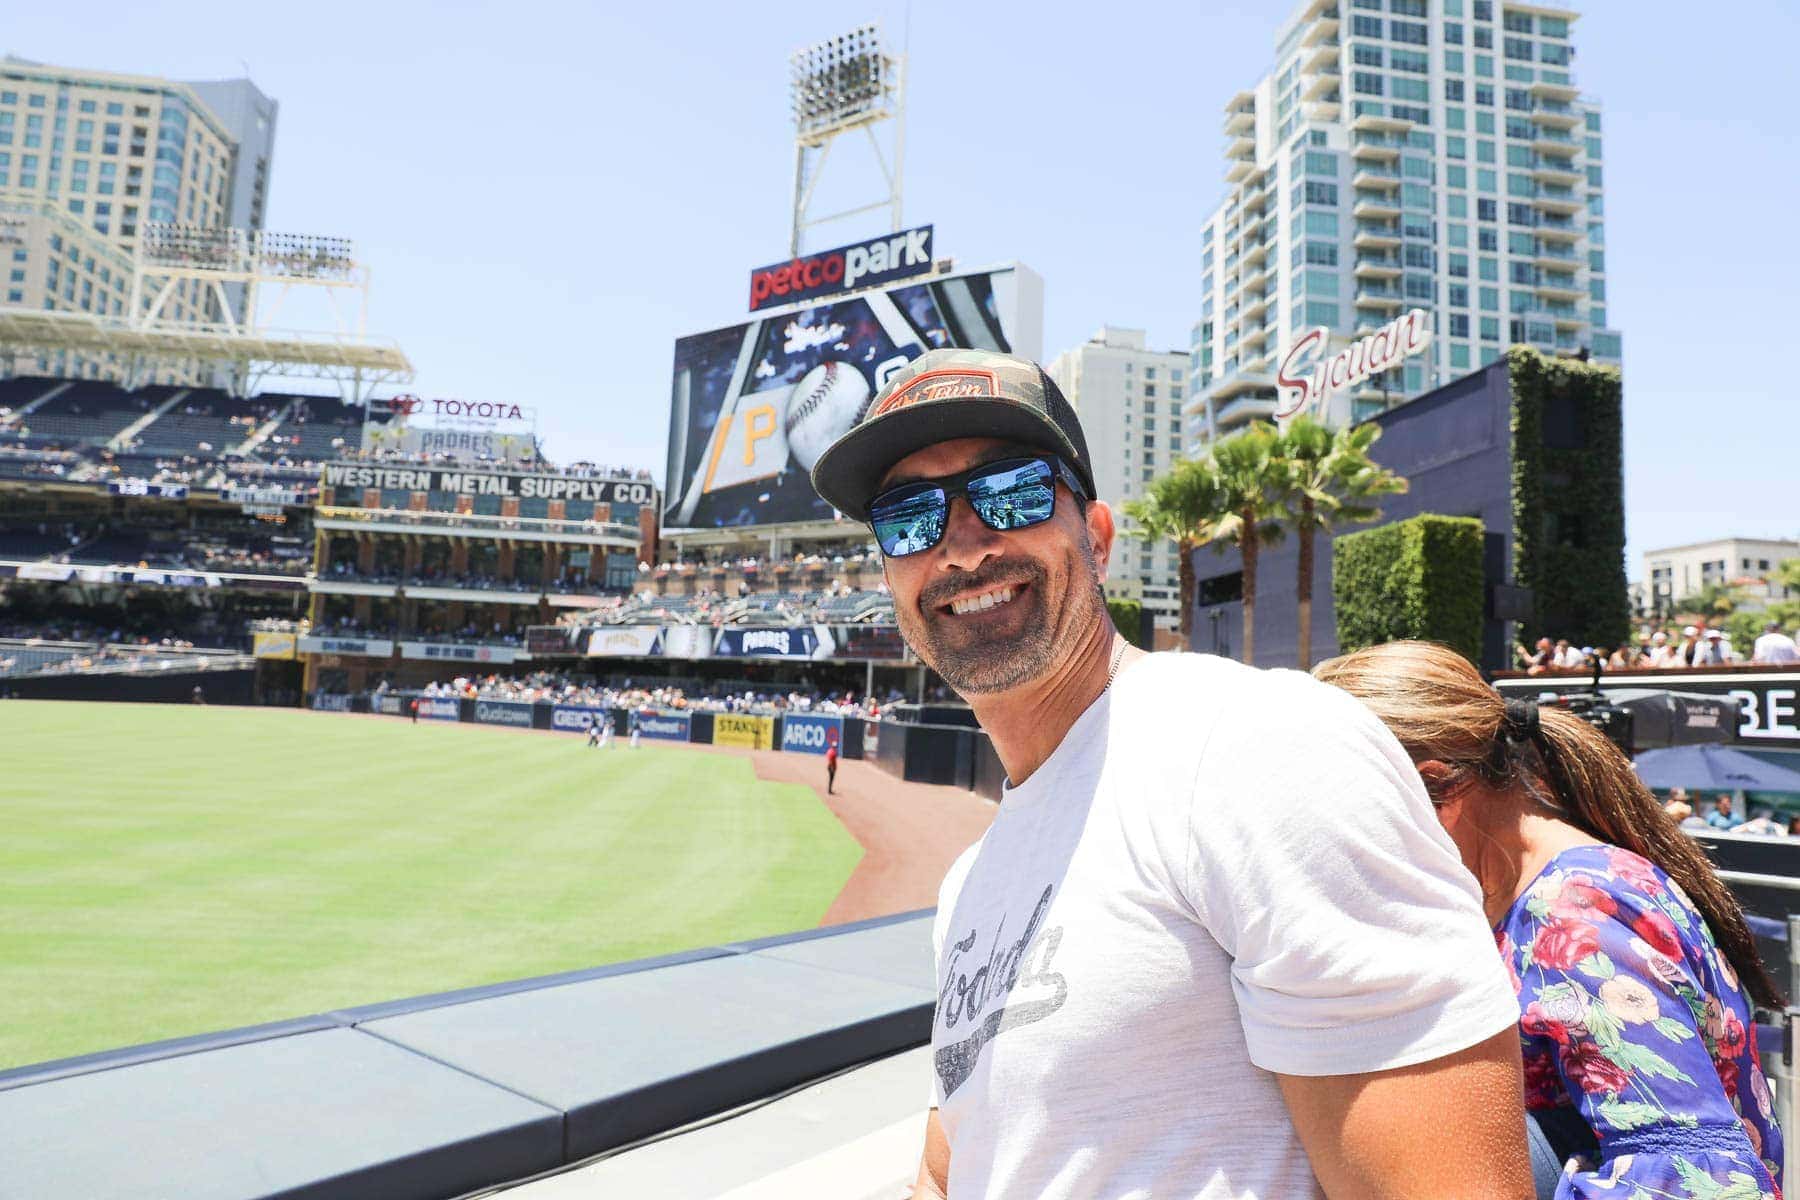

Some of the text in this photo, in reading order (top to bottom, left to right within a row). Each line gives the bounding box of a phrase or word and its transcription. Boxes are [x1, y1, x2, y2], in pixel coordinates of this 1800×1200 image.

[1274, 308, 1433, 424] Sycuan
[432, 399, 522, 419] TOYOTA
[743, 404, 777, 467] P
[326, 466, 651, 504] WESTERN METAL SUPPLY CO.
[783, 723, 825, 747] ARCO
